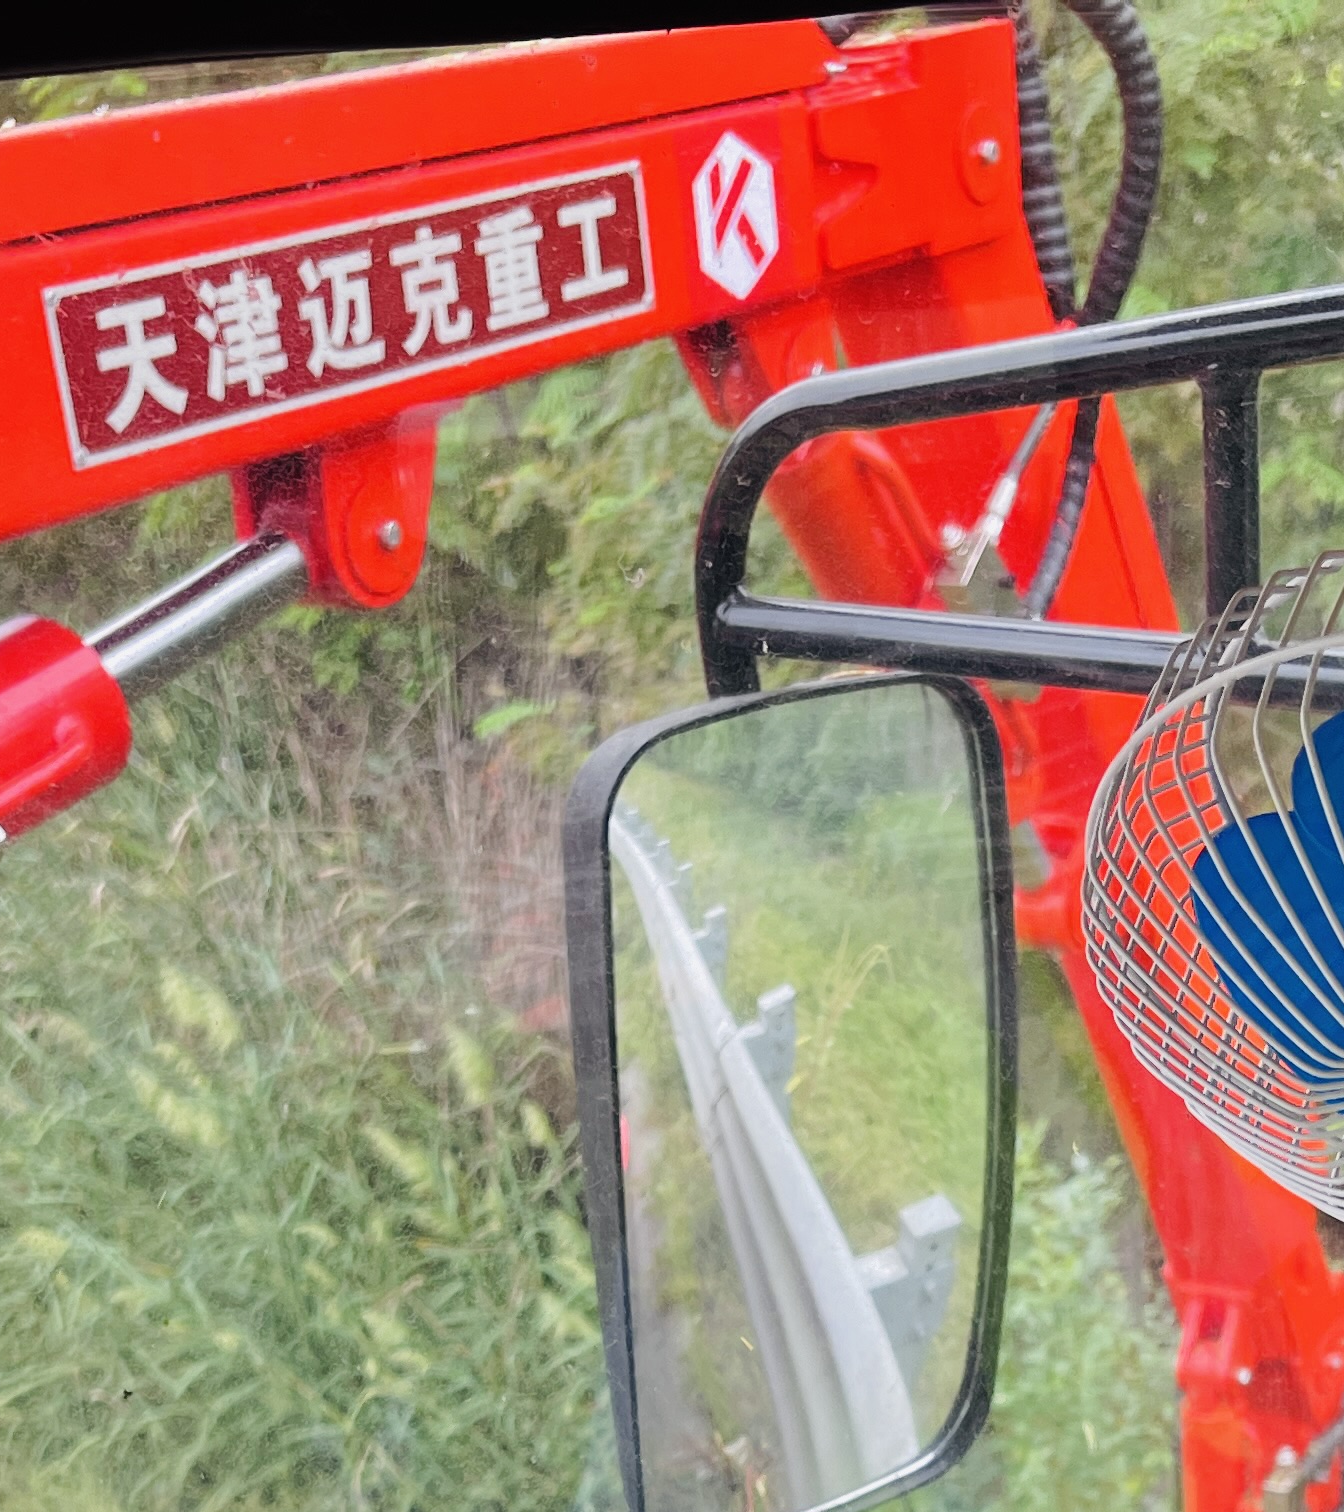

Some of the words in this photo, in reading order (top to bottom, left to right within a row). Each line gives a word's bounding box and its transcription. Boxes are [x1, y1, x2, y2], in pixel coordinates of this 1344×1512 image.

[95, 197, 629, 434] 天津迈克重工
